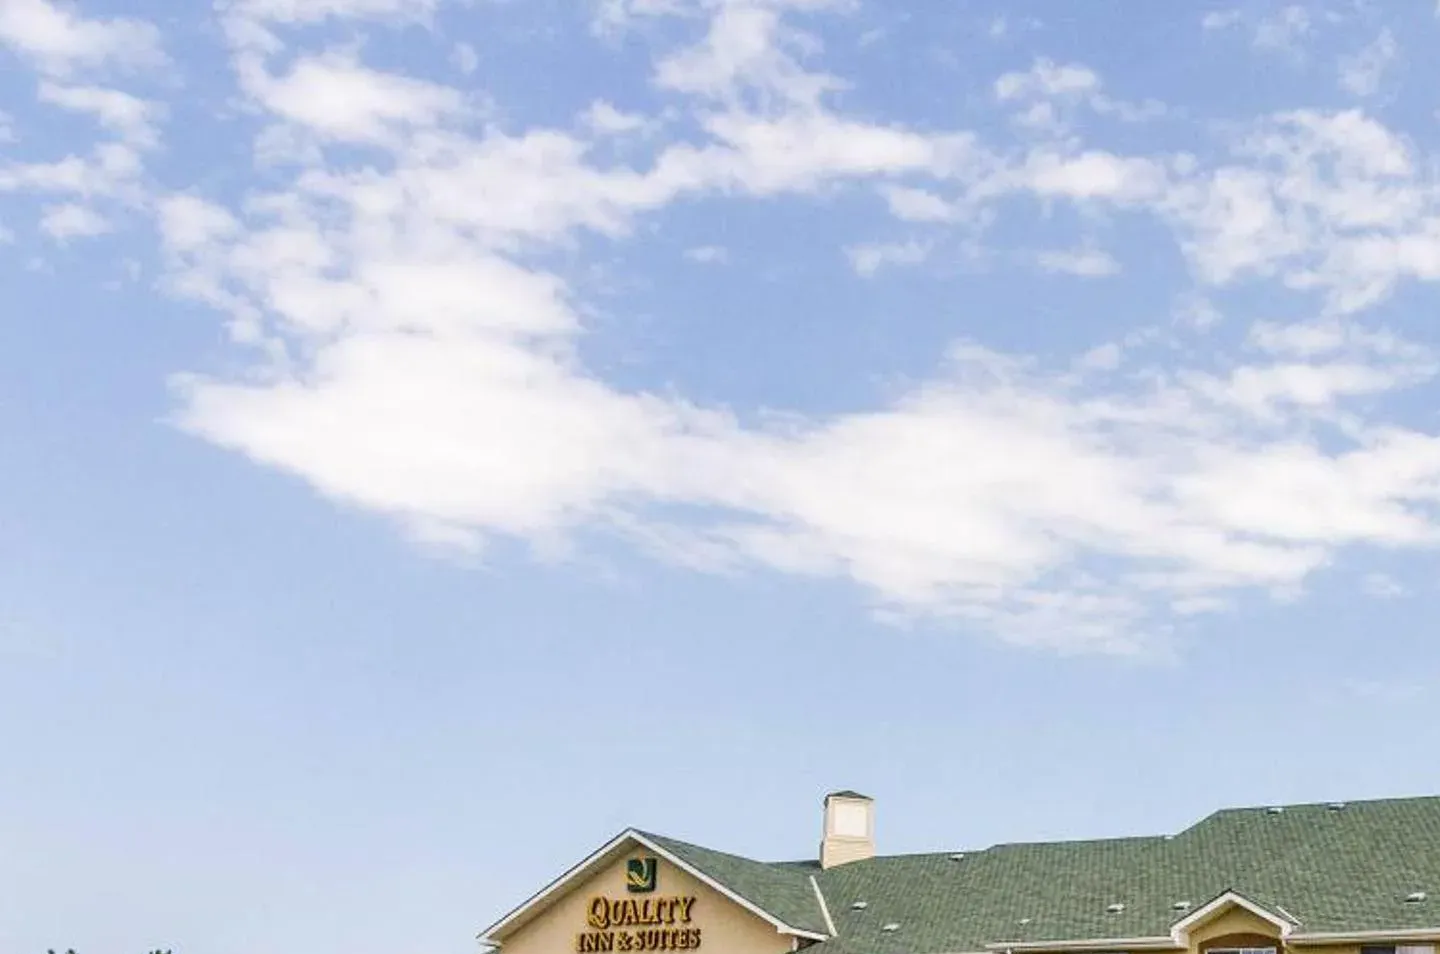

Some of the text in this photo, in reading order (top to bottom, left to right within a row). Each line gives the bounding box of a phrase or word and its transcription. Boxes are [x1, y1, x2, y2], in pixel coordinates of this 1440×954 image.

[587, 896, 697, 929] QUALITY
[578, 928, 702, 952] INN & SUITES
